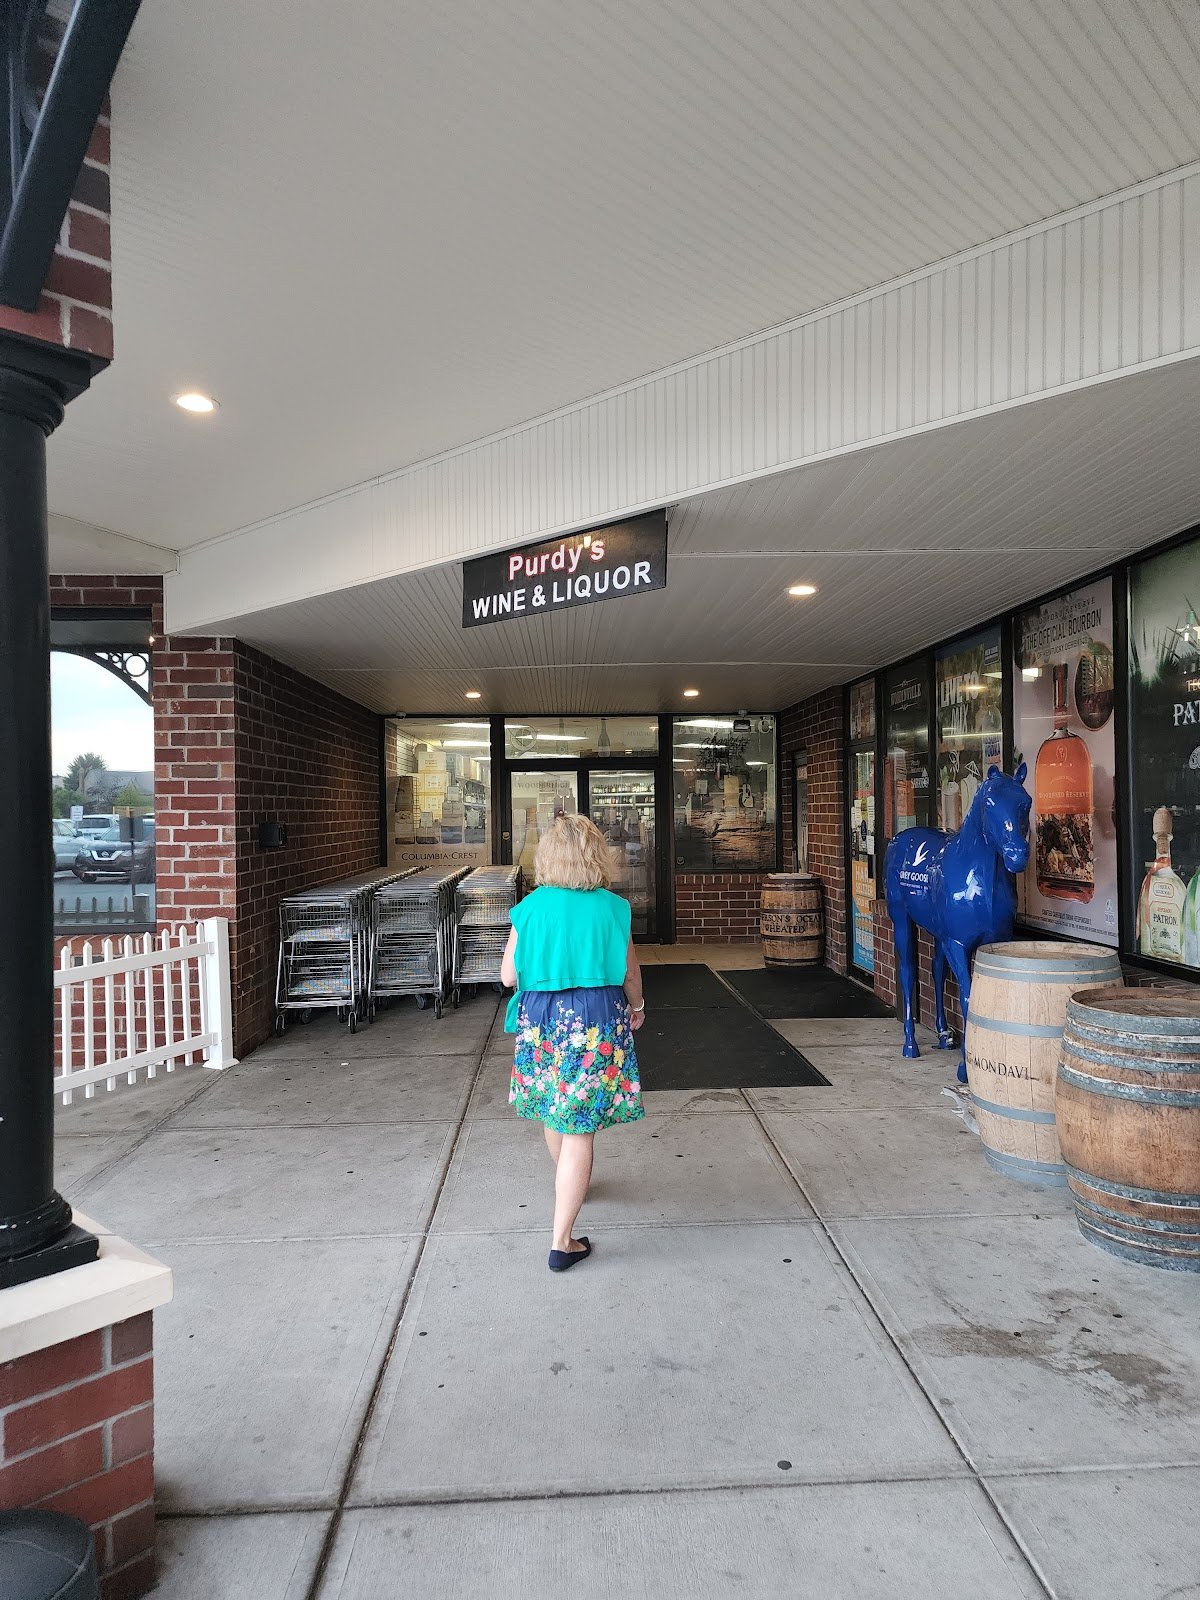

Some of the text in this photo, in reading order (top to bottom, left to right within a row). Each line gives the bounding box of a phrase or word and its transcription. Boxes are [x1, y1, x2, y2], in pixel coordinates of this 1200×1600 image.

[508, 535, 606, 581] Purdy's
[472, 560, 652, 619] WINE & LIQUOR
[1026, 631, 1037, 650] THE
[1068, 607, 1102, 636] BOURBON
[940, 670, 979, 708] LIVE TO
